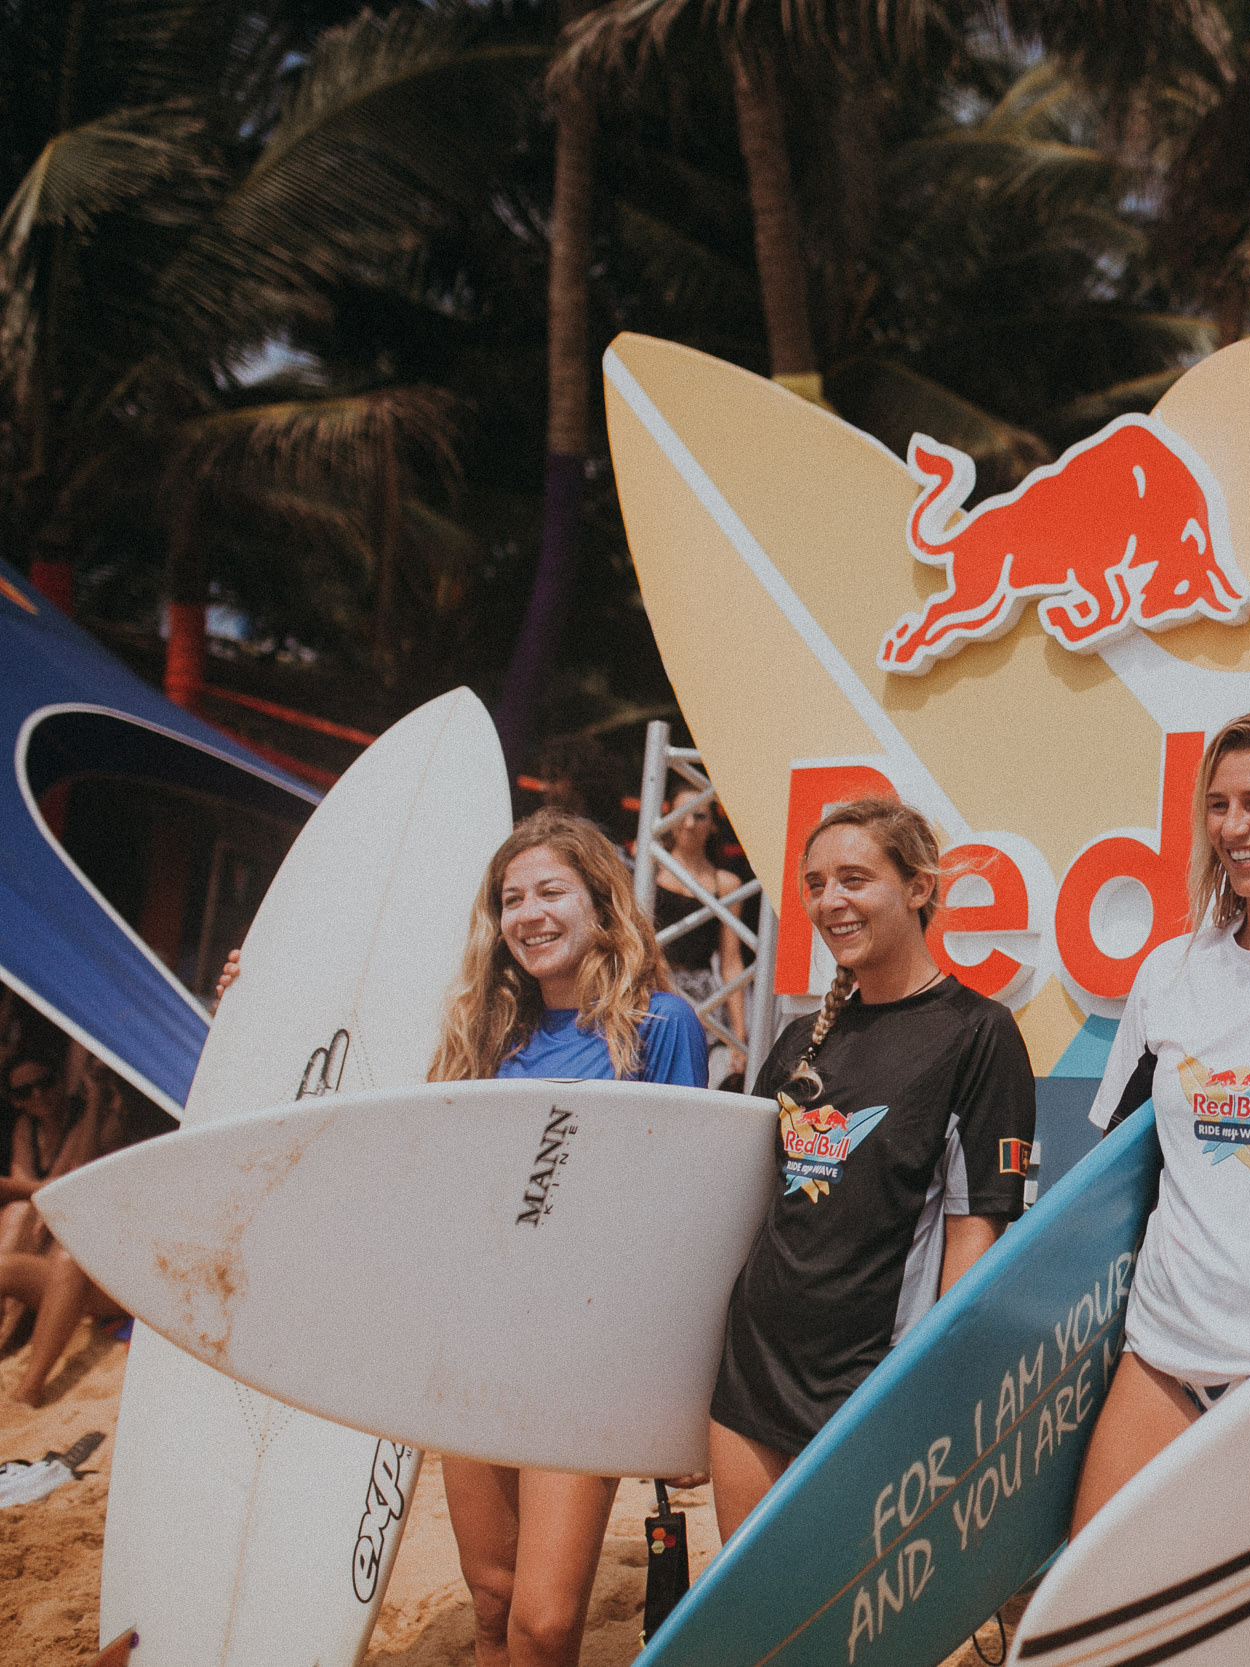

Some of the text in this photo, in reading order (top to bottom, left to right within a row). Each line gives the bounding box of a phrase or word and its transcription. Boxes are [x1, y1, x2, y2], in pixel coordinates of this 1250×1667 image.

[773, 730, 1206, 999] Red
[515, 1104, 573, 1227] MANN
[785, 1130, 850, 1159] Red Bull
[1193, 1093, 1234, 1116] Red
[1198, 1124, 1220, 1136] RIDE
[1222, 1128, 1239, 1140] my
[786, 1160, 802, 1172] RIDE
[812, 1164, 839, 1178] WAVE
[872, 1252, 1133, 1559] FOR I AM YOUR
[353, 1438, 405, 1603] exp
[848, 1358, 1093, 1664] AND YOU ARE
